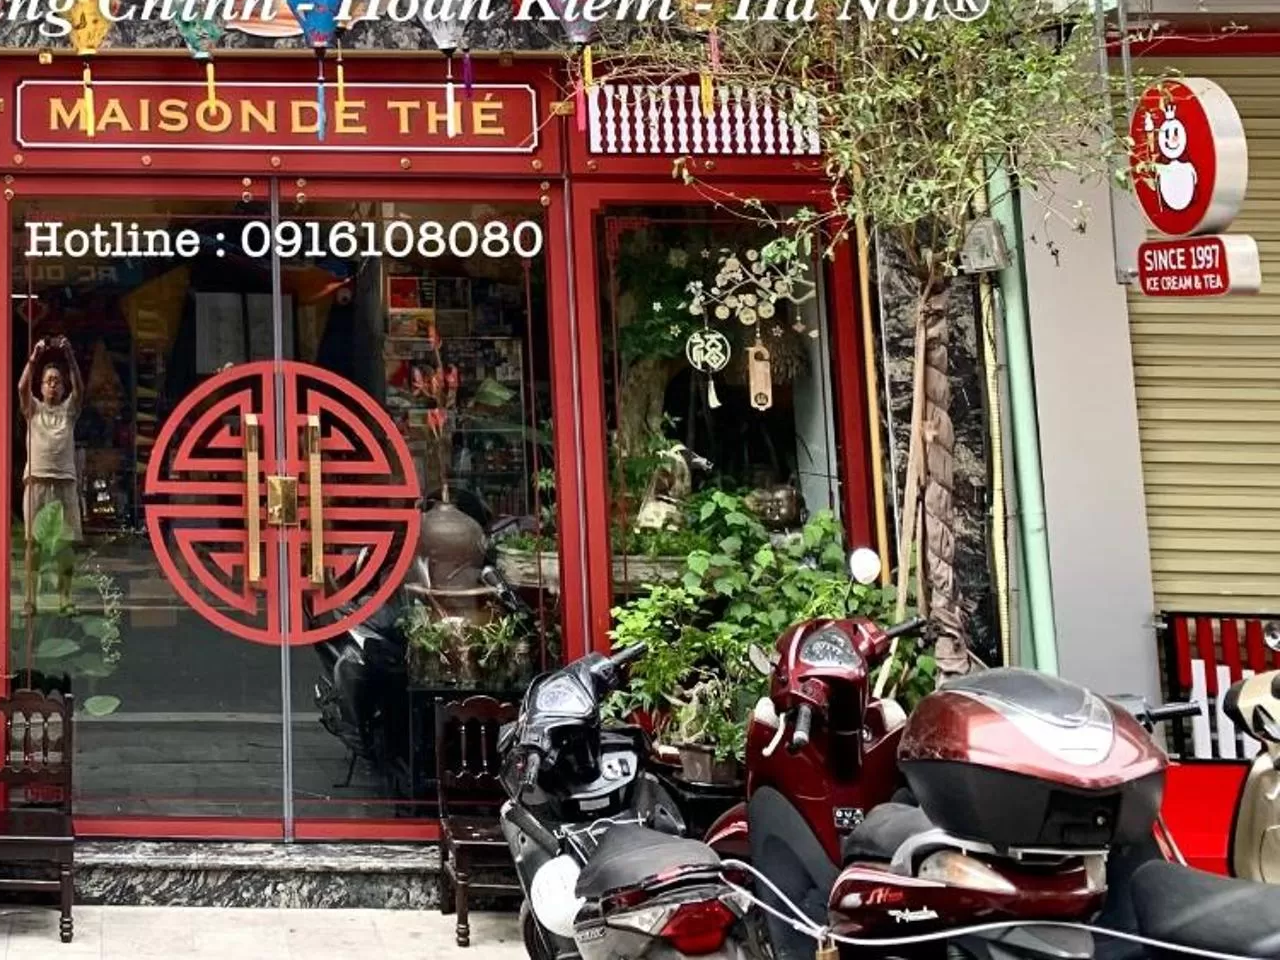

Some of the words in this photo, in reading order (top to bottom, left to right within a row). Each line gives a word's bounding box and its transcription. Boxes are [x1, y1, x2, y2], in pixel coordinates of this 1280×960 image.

[387, 94, 505, 135] THÉ
[1144, 248, 1187, 271] SINCE
[1189, 244, 1220, 270] 1997
[1161, 275, 1192, 290] CREAM
[1203, 273, 1223, 289] TEA
